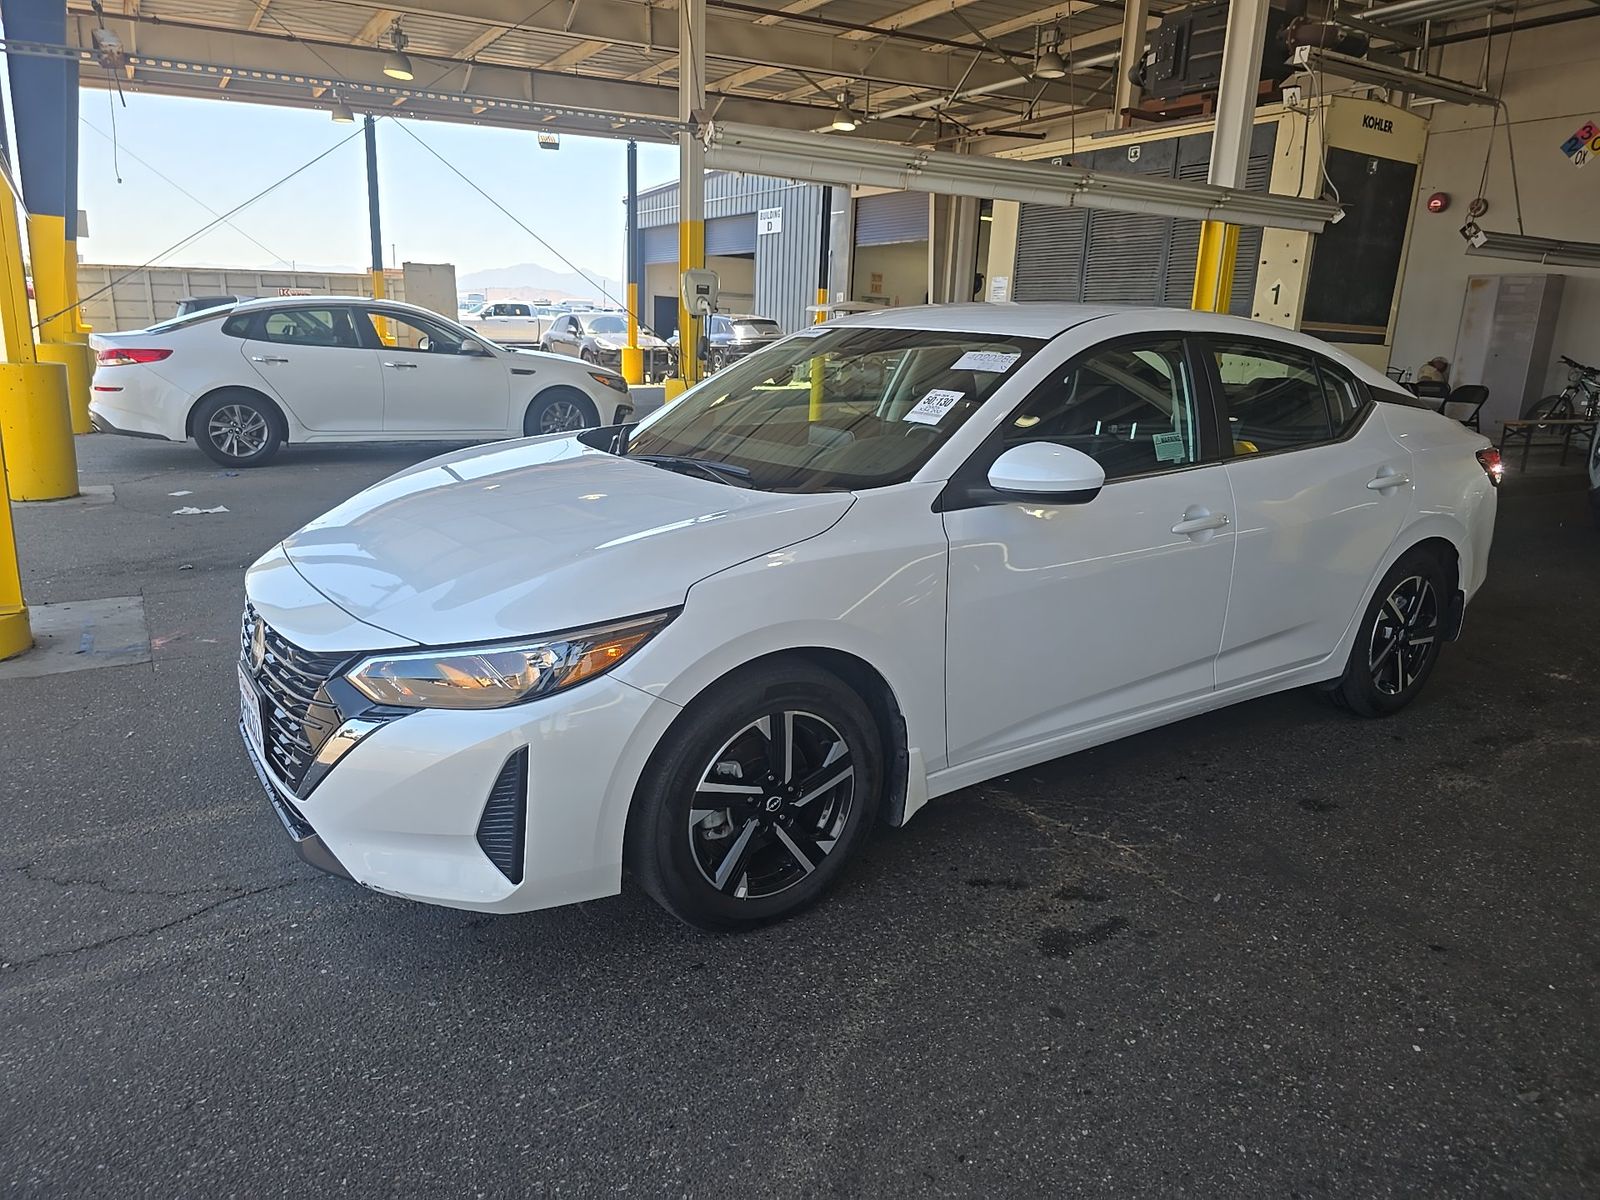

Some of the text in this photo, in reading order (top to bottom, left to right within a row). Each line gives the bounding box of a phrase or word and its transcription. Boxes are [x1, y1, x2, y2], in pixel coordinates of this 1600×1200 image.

[1362, 114, 1393, 134] KOHLER
[1581, 125, 1593, 140] 3
[1568, 137, 1579, 152] 2
[1575, 150, 1588, 165] OX
[760, 209, 780, 220] BUILDING
[768, 221, 773, 231] D
[1271, 284, 1281, 305] 1
[1160, 435, 1182, 443] WARNING
